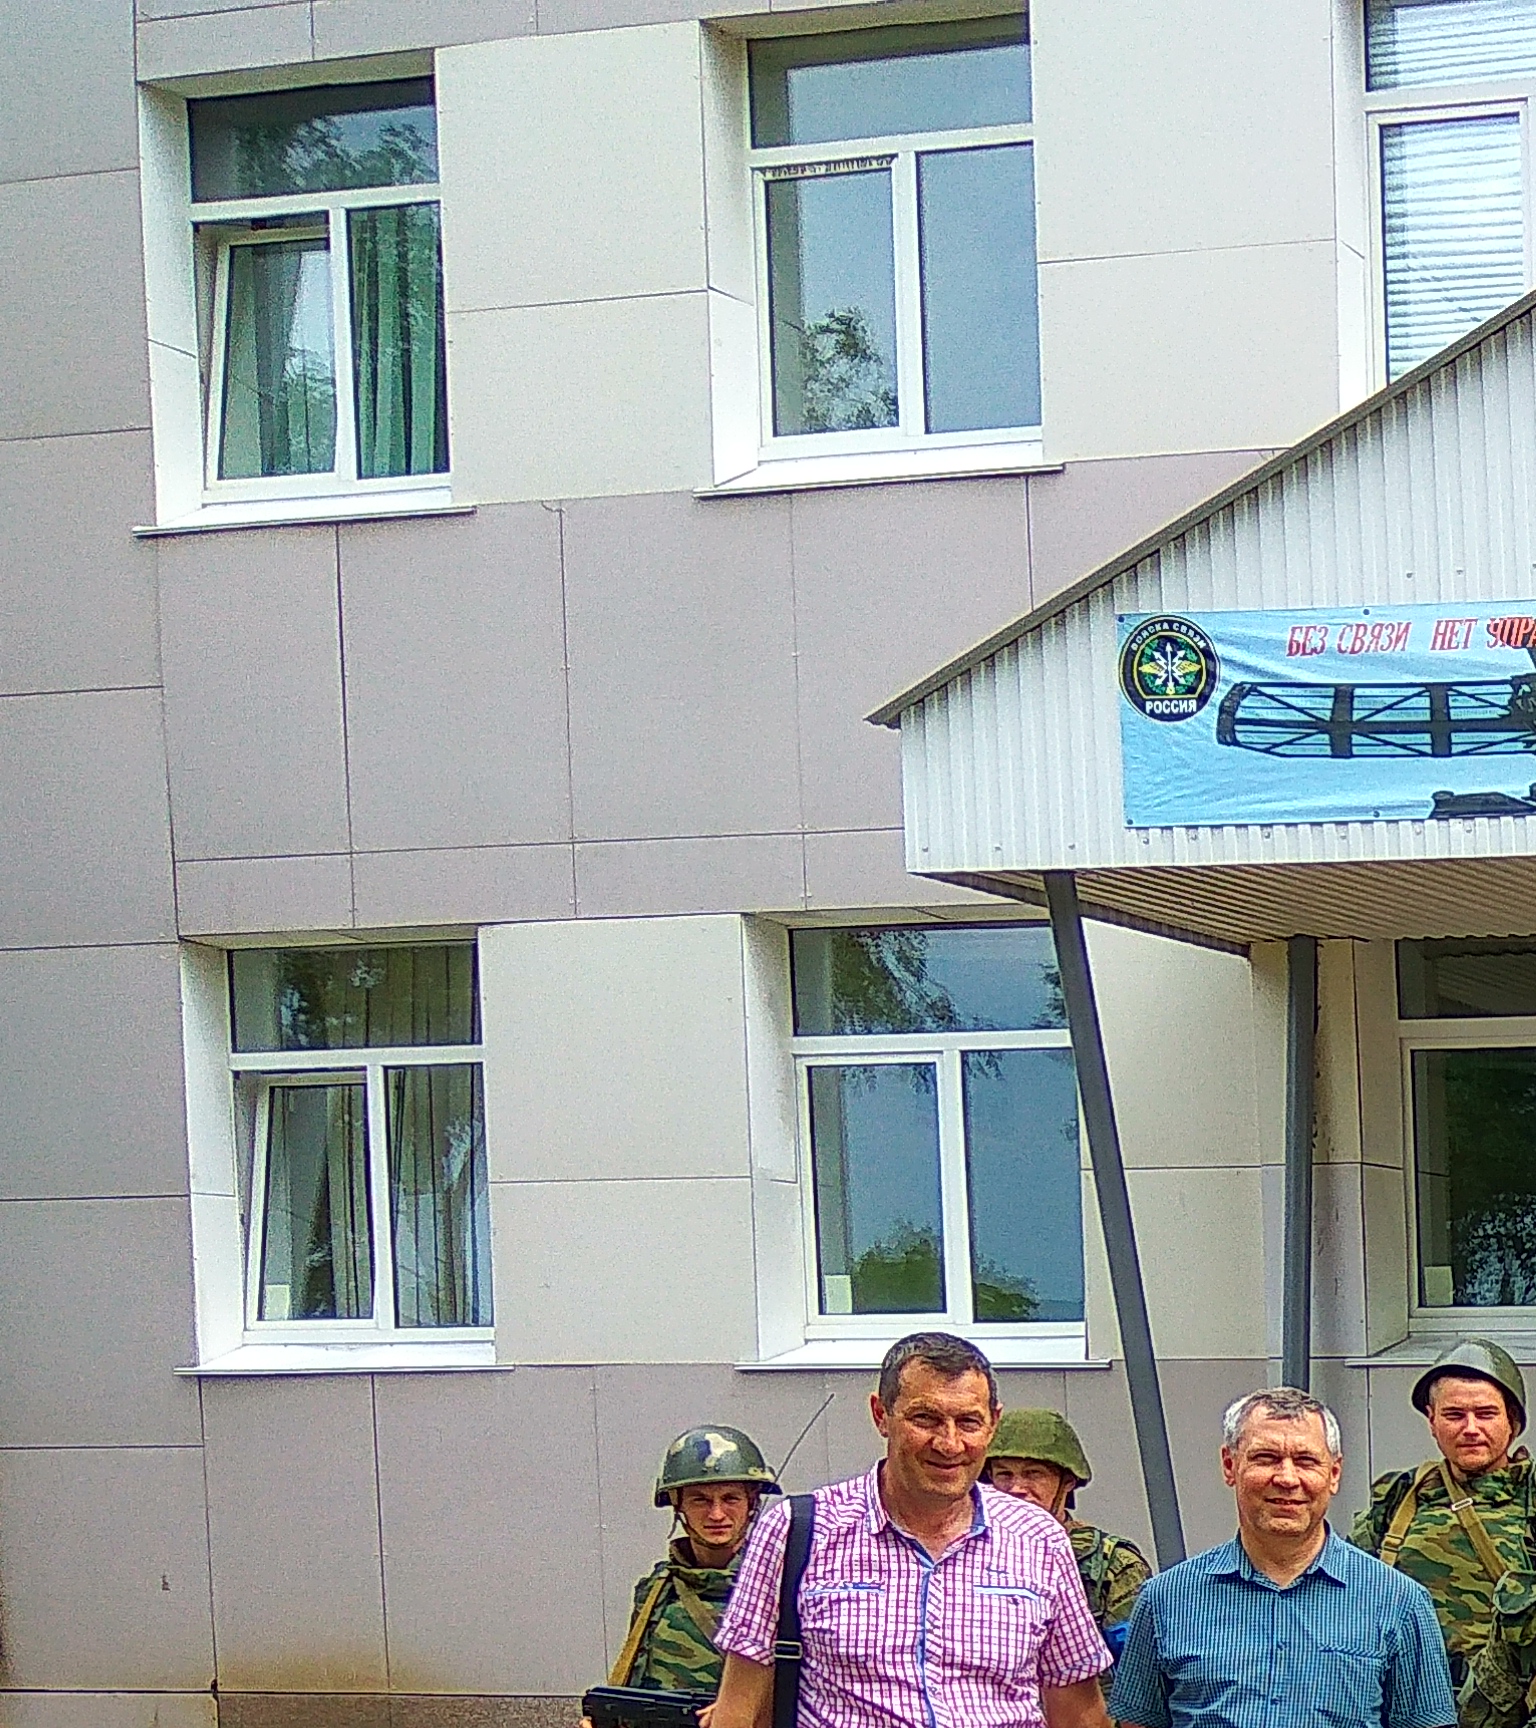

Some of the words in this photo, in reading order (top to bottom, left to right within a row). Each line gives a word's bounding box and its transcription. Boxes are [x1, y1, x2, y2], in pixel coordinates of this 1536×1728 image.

[1286, 625, 1329, 657] БЕЗ
[1337, 622, 1412, 654] СВЯЗИ
[1430, 618, 1478, 651] НЕТ
[1145, 700, 1197, 714] РОССИЯ
